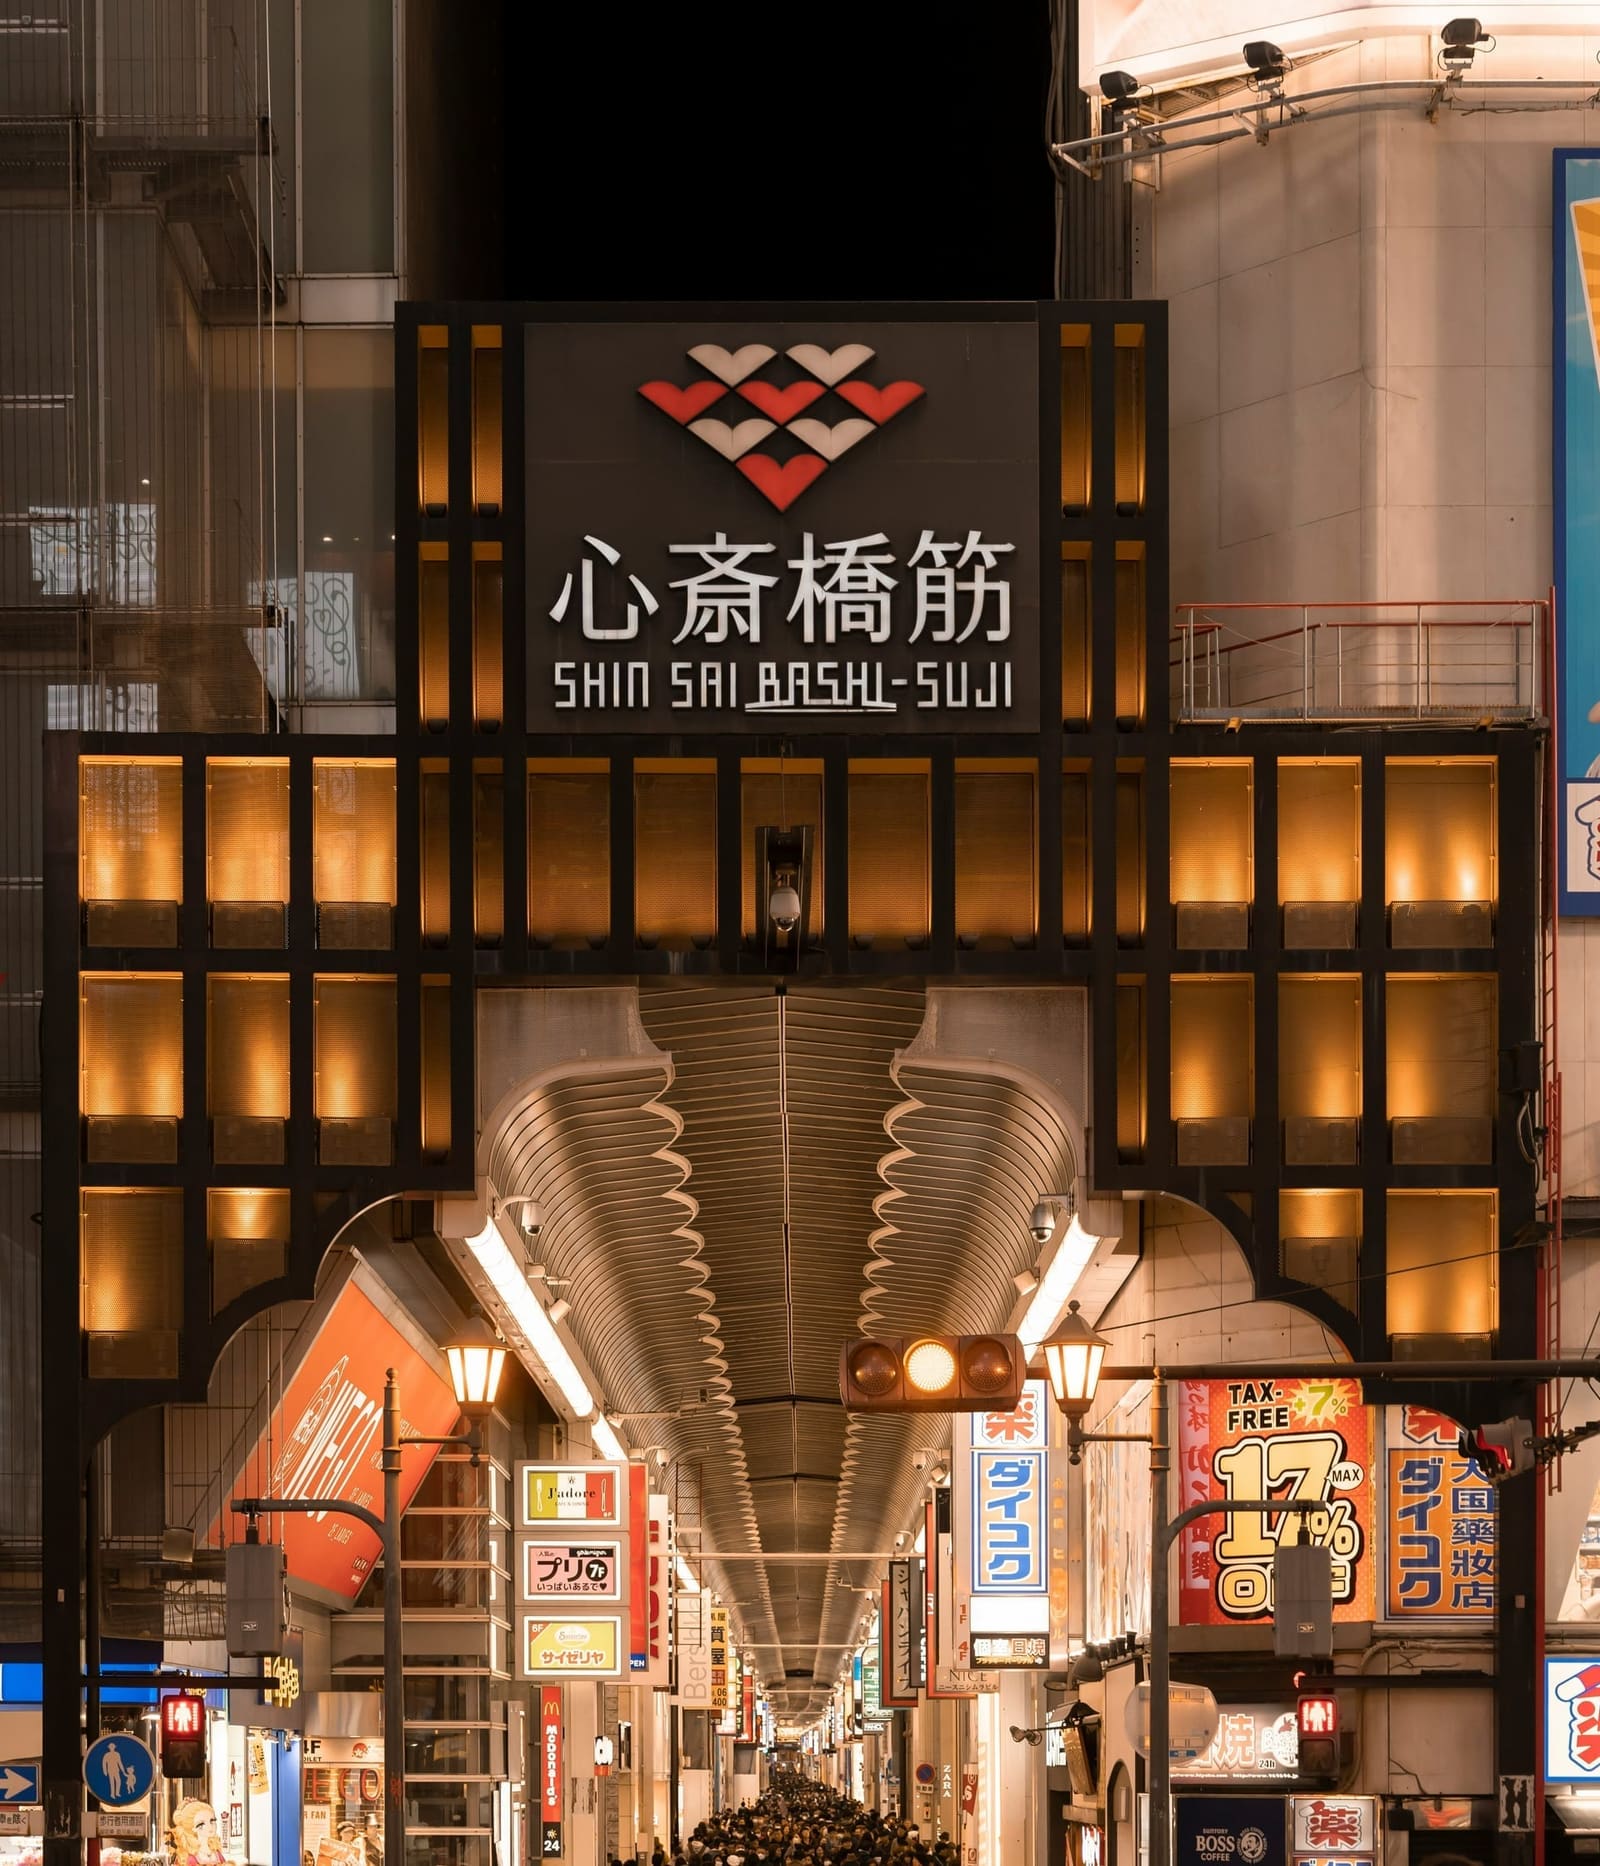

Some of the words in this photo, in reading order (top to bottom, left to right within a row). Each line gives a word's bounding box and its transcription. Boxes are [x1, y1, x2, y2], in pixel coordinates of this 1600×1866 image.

[549, 529, 1016, 644] 心斎橋筋
[554, 661, 649, 708] SHIN
[671, 661, 737, 708] SAI
[1228, 1381, 1282, 1405] TAX-
[1227, 1406, 1289, 1431] FREE
[1331, 1467, 1361, 1483] MAX
[547, 1487, 596, 1499] J'adore
[1218, 1437, 1356, 1559] 17%
[987, 1459, 1034, 1581] ダイコク
[1397, 1456, 1444, 1609] ダイコク
[536, 1557, 583, 1582] プリ
[589, 1564, 605, 1578] 7F
[531, 1623, 544, 1633] 6F
[541, 1650, 605, 1665] サイゼリヤ
[629, 1659, 646, 1668] PEN
[545, 1724, 558, 1807] McDonald's
[303, 1767, 383, 1802] EGO
[942, 1764, 952, 1798] ZARA
[1308, 1806, 1360, 1848] 薬
[544, 1839, 561, 1852] 24
[1195, 1834, 1236, 1853] BOSS
[1200, 1852, 1231, 1862] COFFEE
